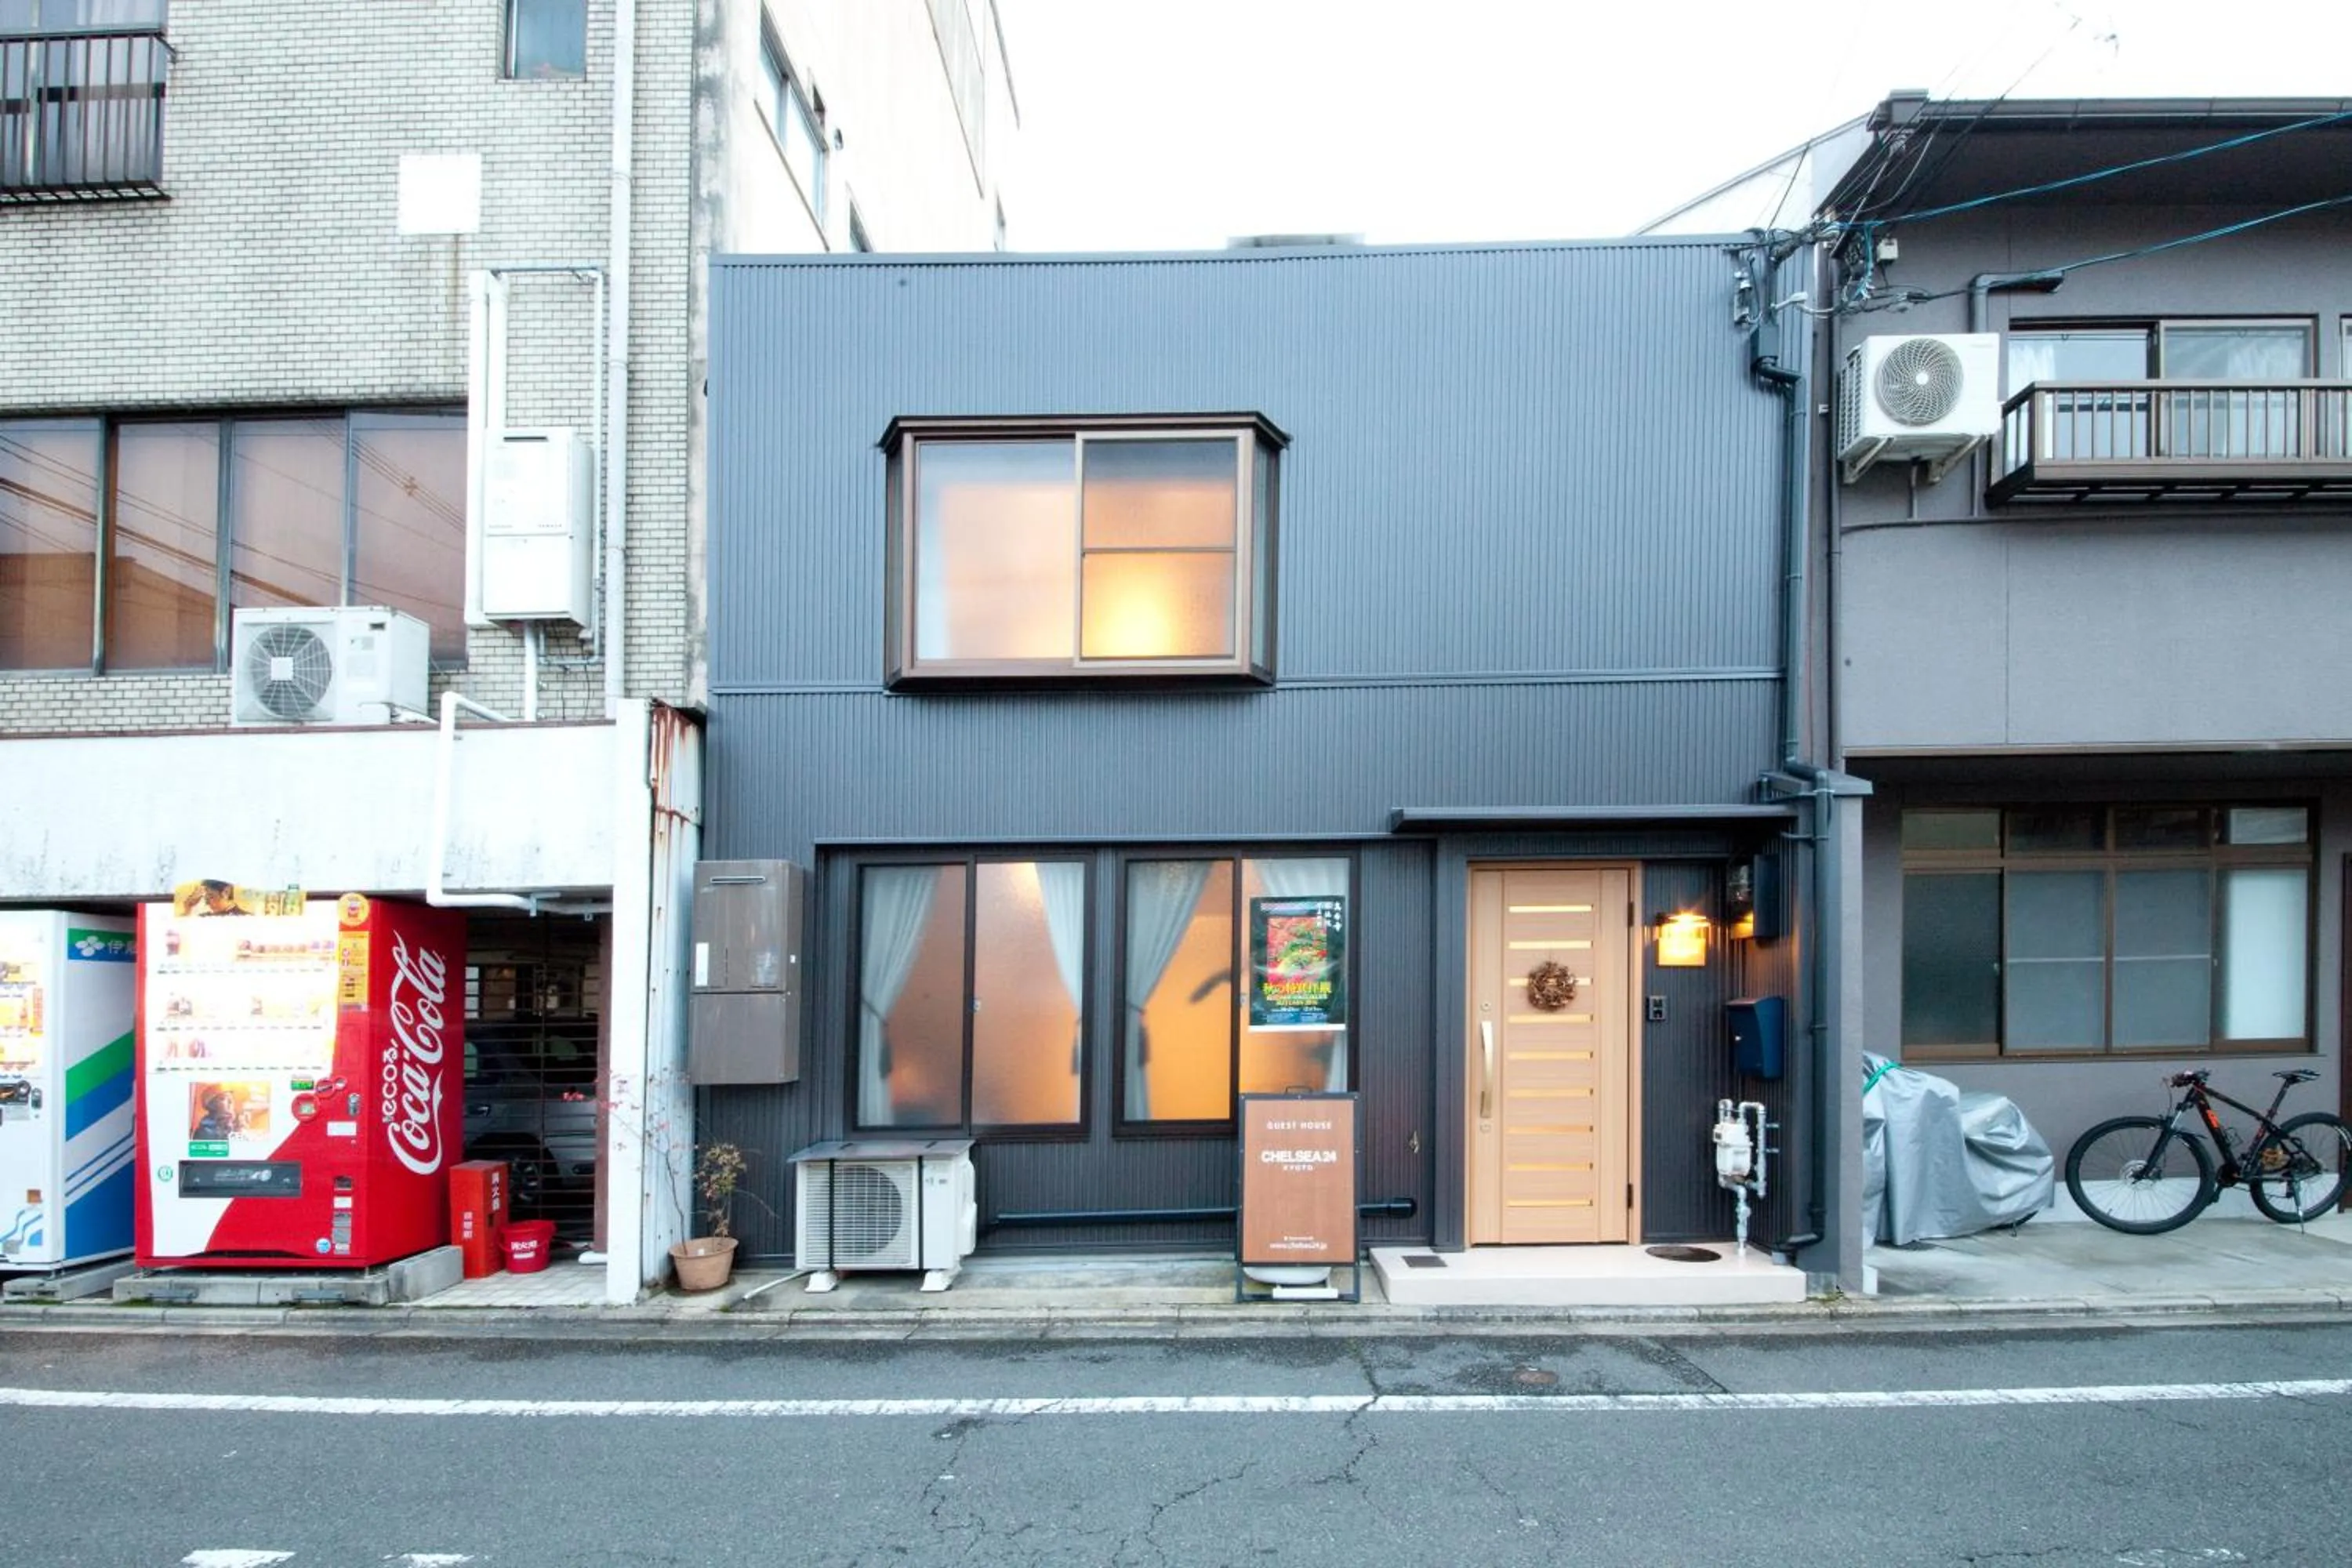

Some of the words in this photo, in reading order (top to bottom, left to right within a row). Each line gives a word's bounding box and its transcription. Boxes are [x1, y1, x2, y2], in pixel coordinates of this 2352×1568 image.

[388, 929, 445, 1174] Coca-Cola
[1267, 1121, 1297, 1130] GUEST
[1300, 1121, 1332, 1130] HOUSE
